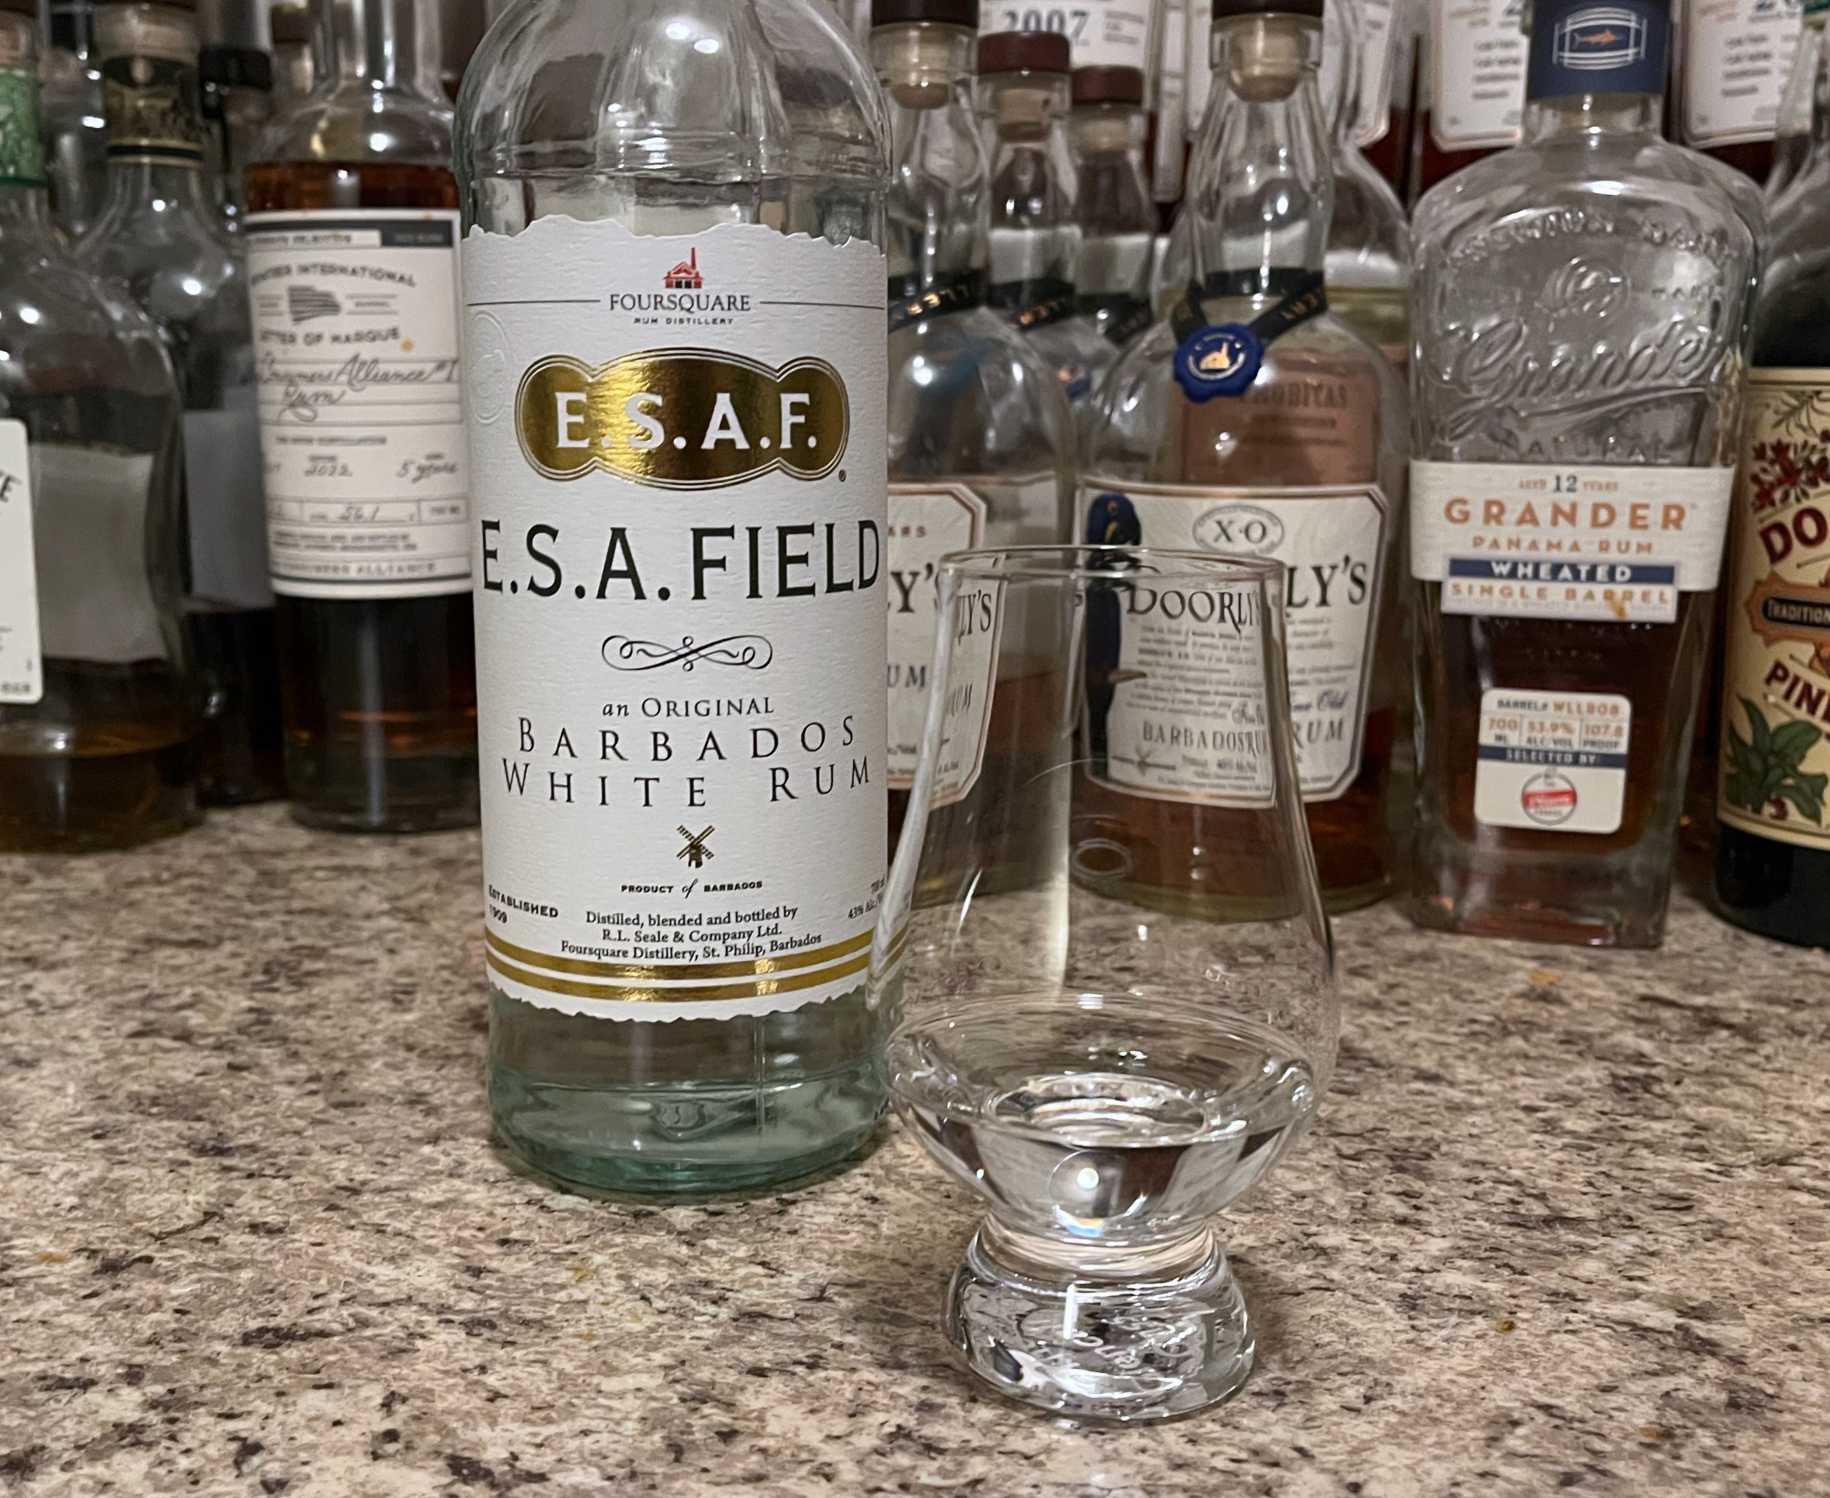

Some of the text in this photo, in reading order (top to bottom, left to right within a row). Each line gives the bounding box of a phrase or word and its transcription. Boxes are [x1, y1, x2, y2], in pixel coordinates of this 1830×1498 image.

[610, 294, 751, 313] FOURSQUARE
[633, 317, 734, 325] RUM DISTILLERY
[555, 391, 817, 450] E.S.A.F.
[1553, 474, 1578, 493] 12
[1444, 497, 1687, 531] GRANDER
[1472, 535, 1653, 555] PANAMA RUM
[1491, 560, 1632, 582] WHEATED
[1451, 582, 1669, 606] SINGLE BARREL
[602, 697, 774, 717] an ORIGINAL
[519, 716, 854, 762] BARBADOS
[1505, 750, 1574, 763] SELECTED
[502, 758, 706, 807] WHITE
[770, 756, 870, 802] RUM
[621, 878, 763, 898] PRODUCT of BARBADOS
[488, 884, 559, 918] ESTABLISHED
[586, 905, 798, 928] Distilled, blended and bottled by
[602, 923, 783, 945] R.L. Seale & Company Ltd.
[561, 933, 822, 963] Foursquare Distillery, St. Philip, Barbados
